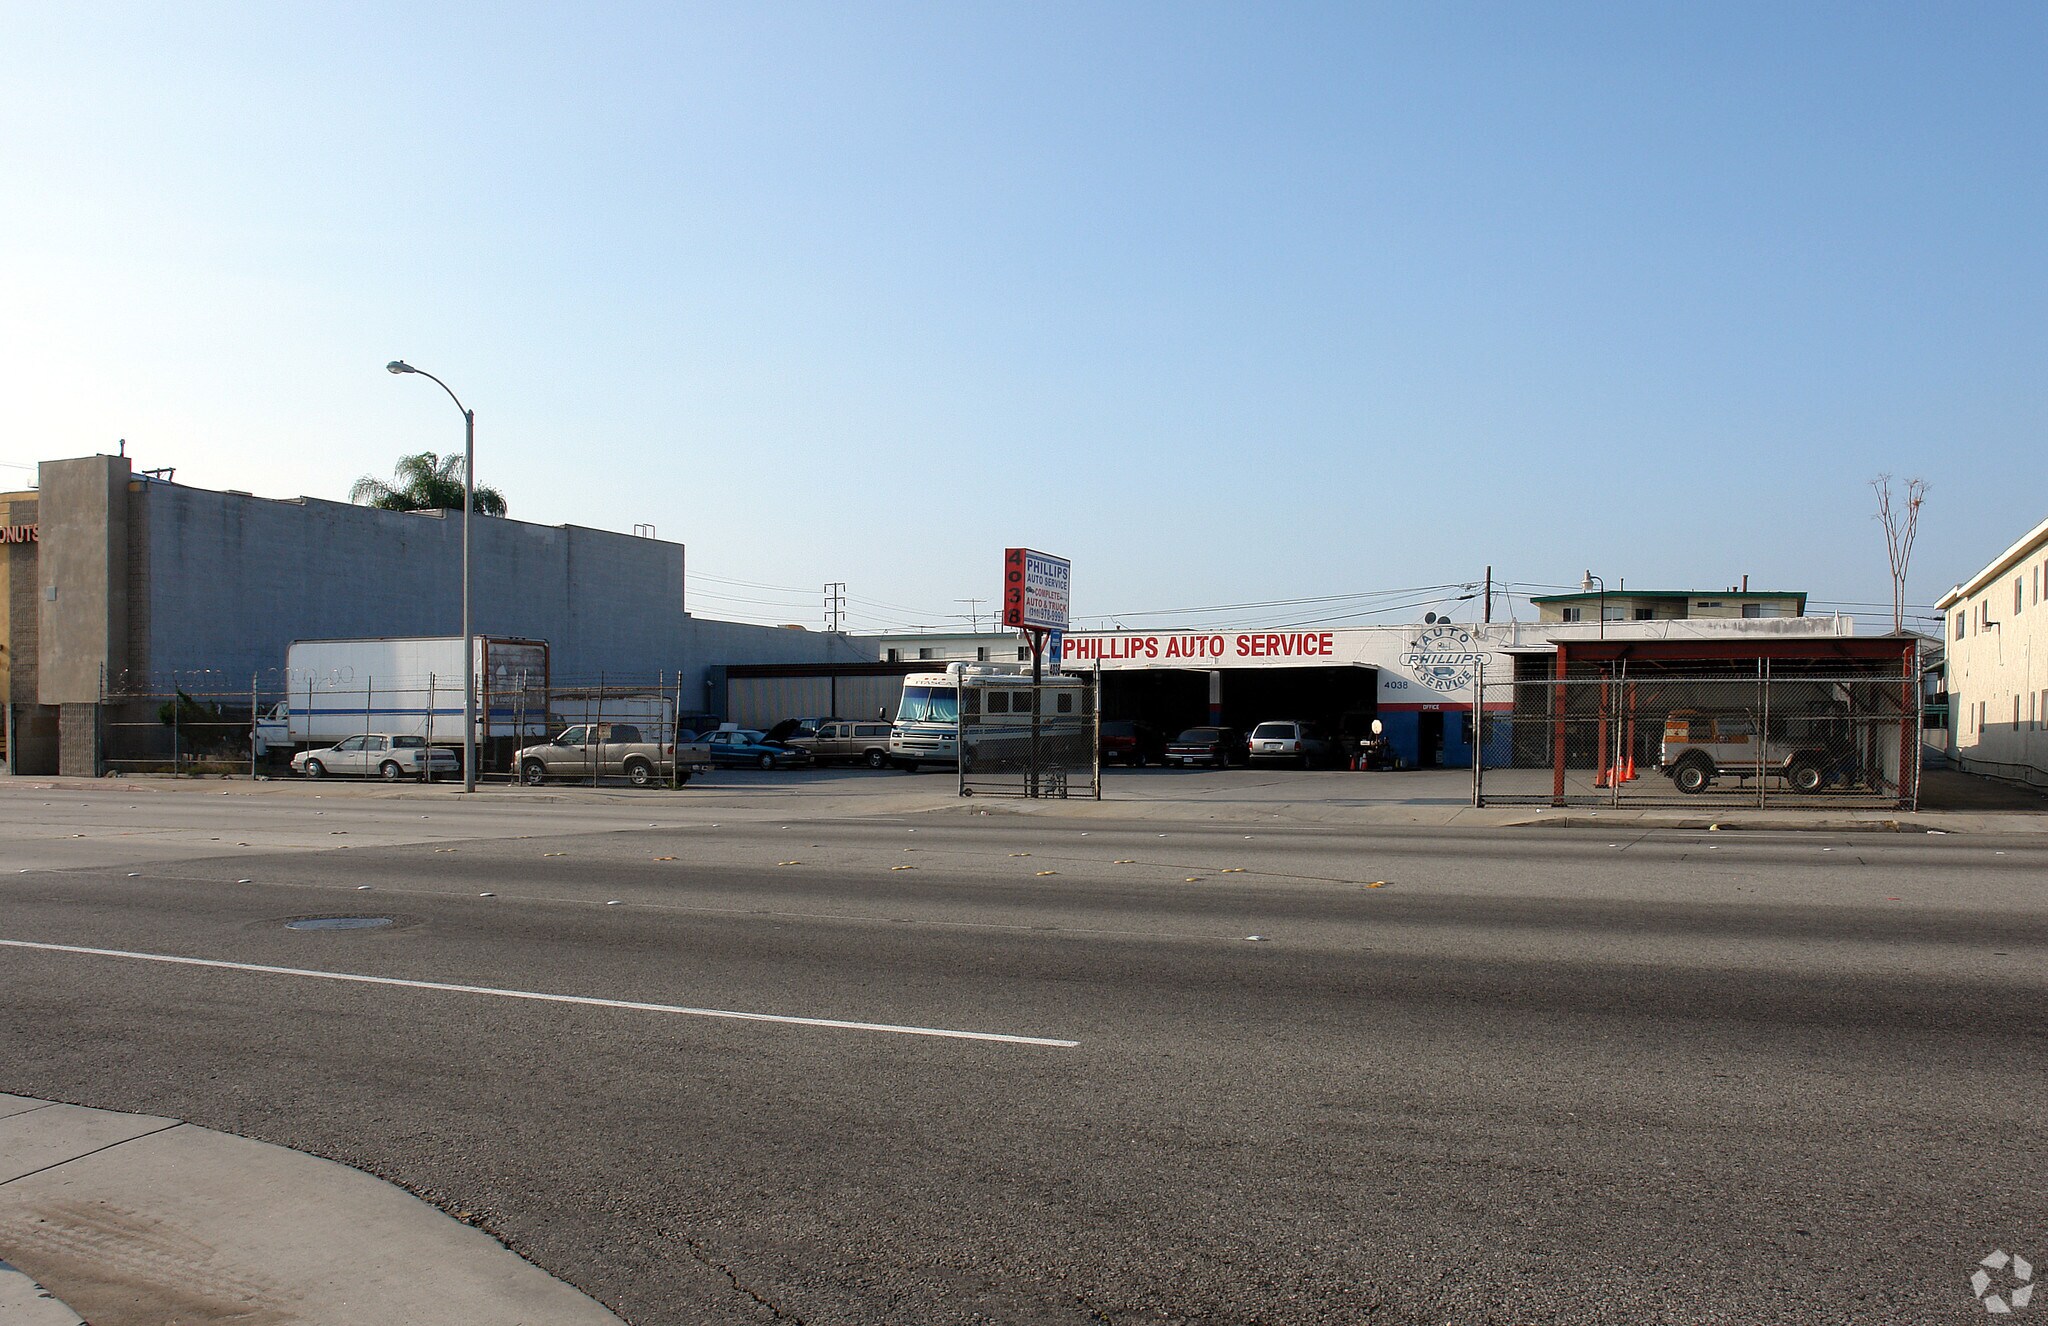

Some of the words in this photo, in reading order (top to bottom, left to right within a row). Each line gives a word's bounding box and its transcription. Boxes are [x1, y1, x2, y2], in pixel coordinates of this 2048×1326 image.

[1027, 559, 1068, 580] PHILLIPS
[1008, 549, 1022, 624] 4038
[1027, 573, 1044, 585] AUTO
[1045, 577, 1067, 590] SERVICE
[1035, 588, 1060, 600] COMPLETE
[1026, 597, 1042, 608] AUTO
[1049, 600, 1067, 613] TRUCK
[1421, 627, 1469, 645] AUTO
[1063, 637, 1158, 660] PHILLIPS
[1165, 635, 1225, 658] AUTO
[1236, 633, 1333, 656] SERVICE
[1408, 654, 1484, 664] PHILLIPS
[1384, 681, 1408, 689] 4038
[1420, 670, 1474, 690] SERVICE
